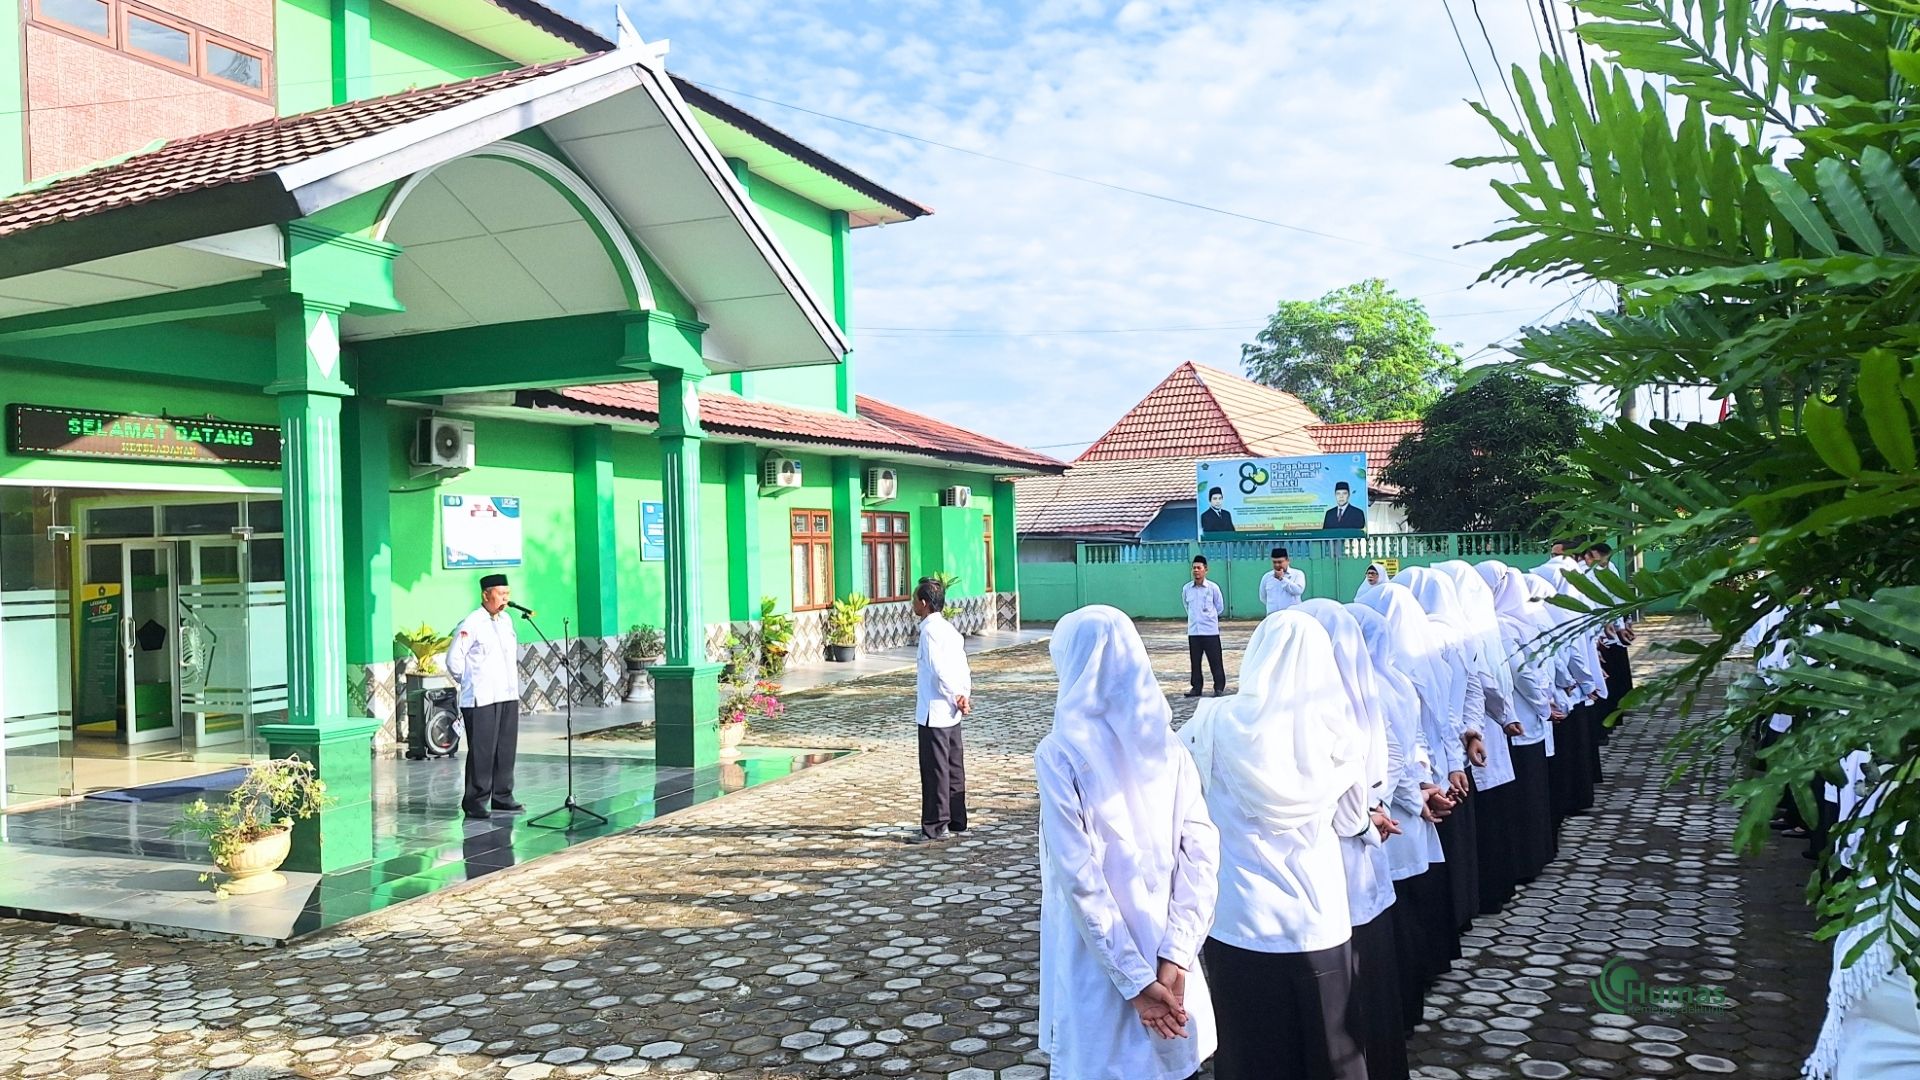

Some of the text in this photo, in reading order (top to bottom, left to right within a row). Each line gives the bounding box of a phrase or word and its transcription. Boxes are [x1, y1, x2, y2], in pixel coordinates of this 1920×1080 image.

[68, 417, 254, 446] SELAMAT DATANG
[1270, 461, 1321, 473] Dirgahayu
[1270, 470, 1319, 480] Hari Amal
[1270, 479, 1299, 488] Bakti
